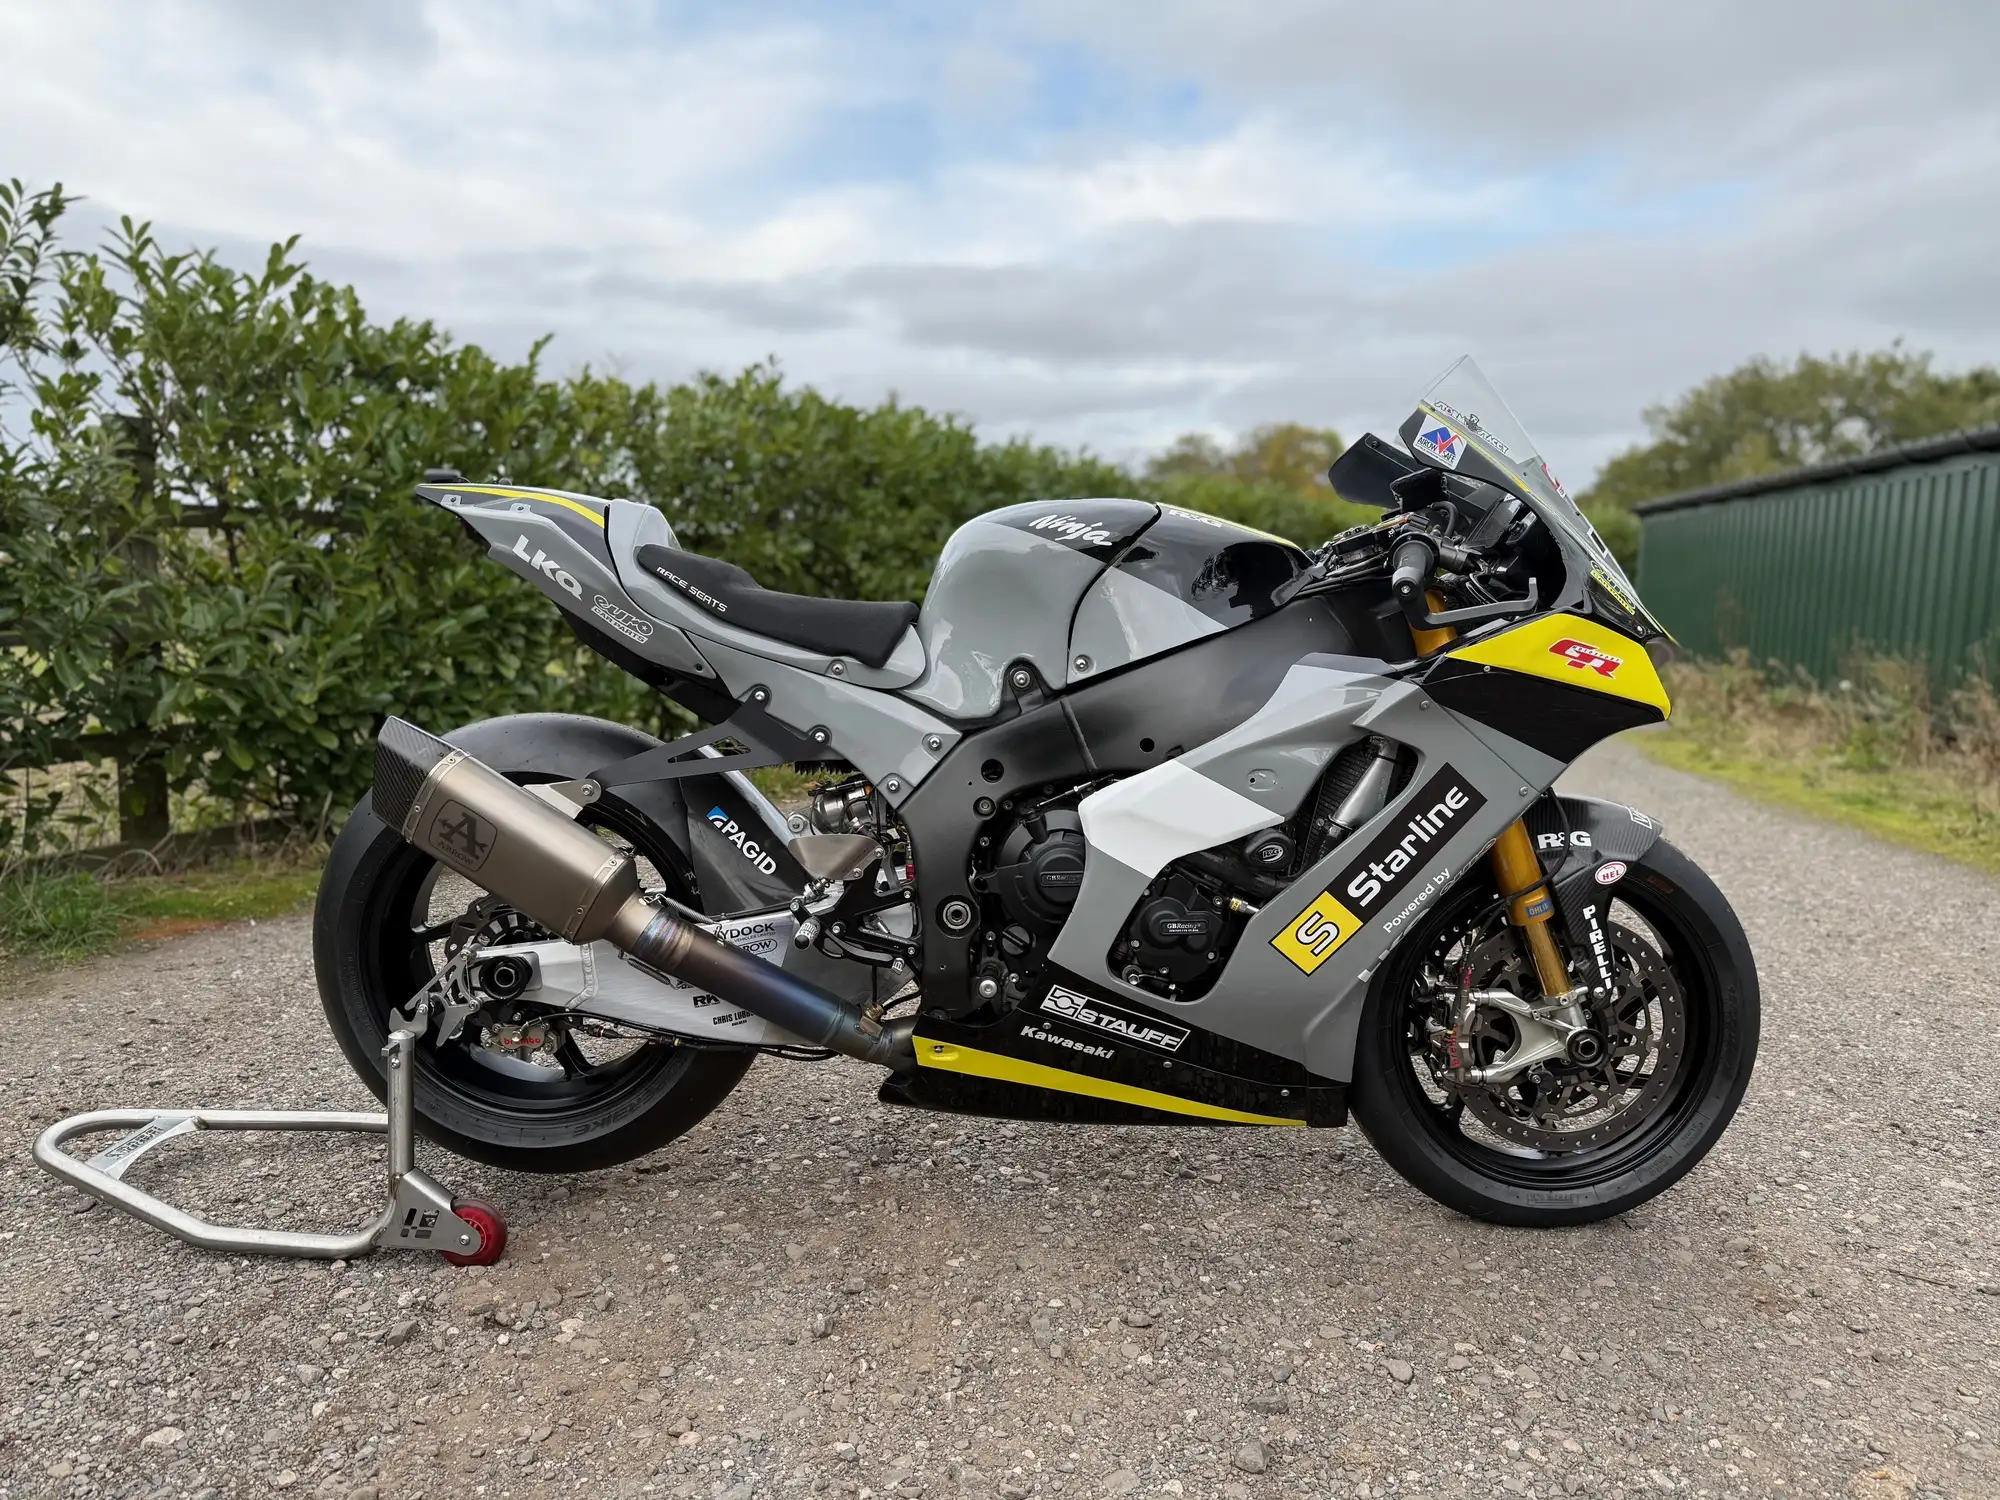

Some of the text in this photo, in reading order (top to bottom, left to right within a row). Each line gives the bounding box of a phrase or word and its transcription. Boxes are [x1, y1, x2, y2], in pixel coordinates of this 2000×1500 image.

[1028, 515, 1113, 546] Ninja
[512, 534, 583, 601] LKQ
[656, 566, 728, 613] RACE SEATS
[594, 607, 645, 642] CAR PARTS
[721, 819, 777, 876] PAGID
[1347, 785, 1470, 908] Starline
[1537, 830, 1592, 849] R&G
[1602, 869, 1620, 881] HEL
[1382, 868, 1450, 933] Powered by
[1528, 902, 1549, 915] ÖHLIN
[717, 922, 775, 940] YDOCK
[742, 940, 772, 953] ROW
[1582, 904, 1612, 990] PIRELLI
[713, 1014, 733, 1025] CHRIS
[1077, 1008, 1181, 1047] STAUFF
[503, 1037, 541, 1045] brmbo
[1020, 1025, 1115, 1059] Kawasaki
[1447, 1023, 1461, 1067] bremo
